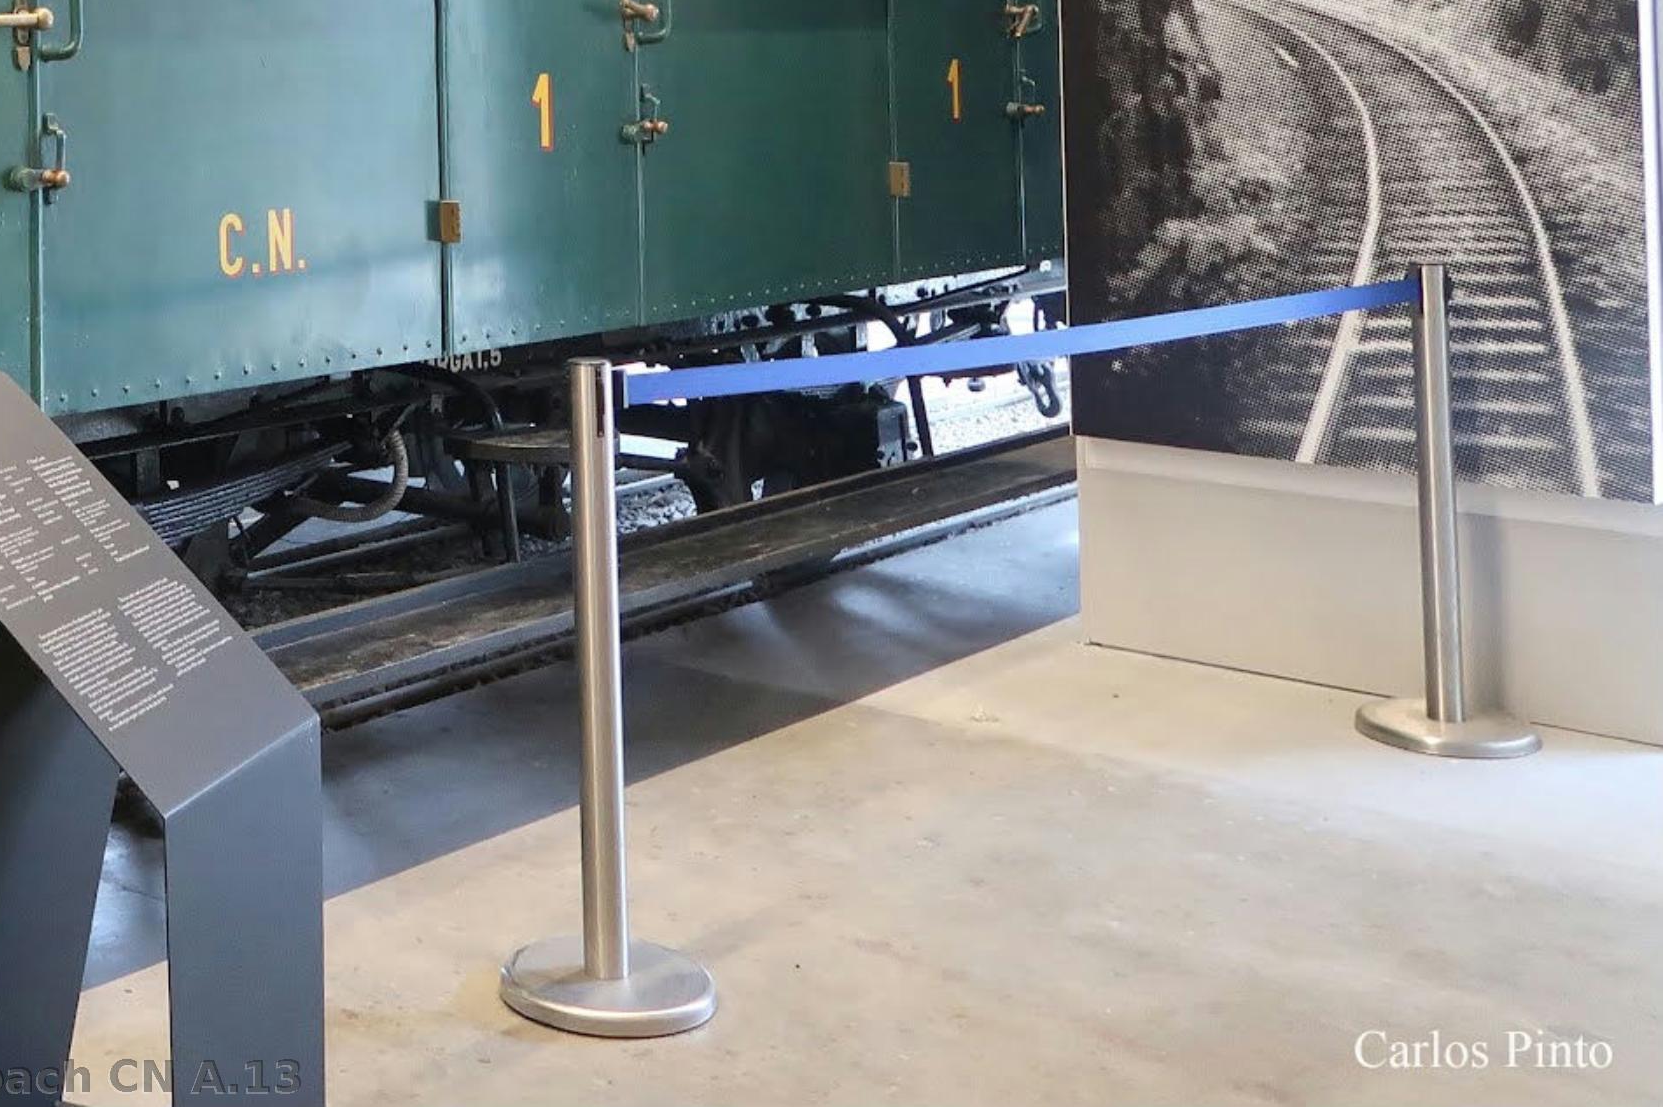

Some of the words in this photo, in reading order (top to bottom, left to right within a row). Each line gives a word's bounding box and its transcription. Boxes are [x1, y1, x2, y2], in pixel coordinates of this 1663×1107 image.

[532, 73, 554, 152] 1
[947, 59, 962, 120] 1
[218, 208, 306, 279] C.N.
